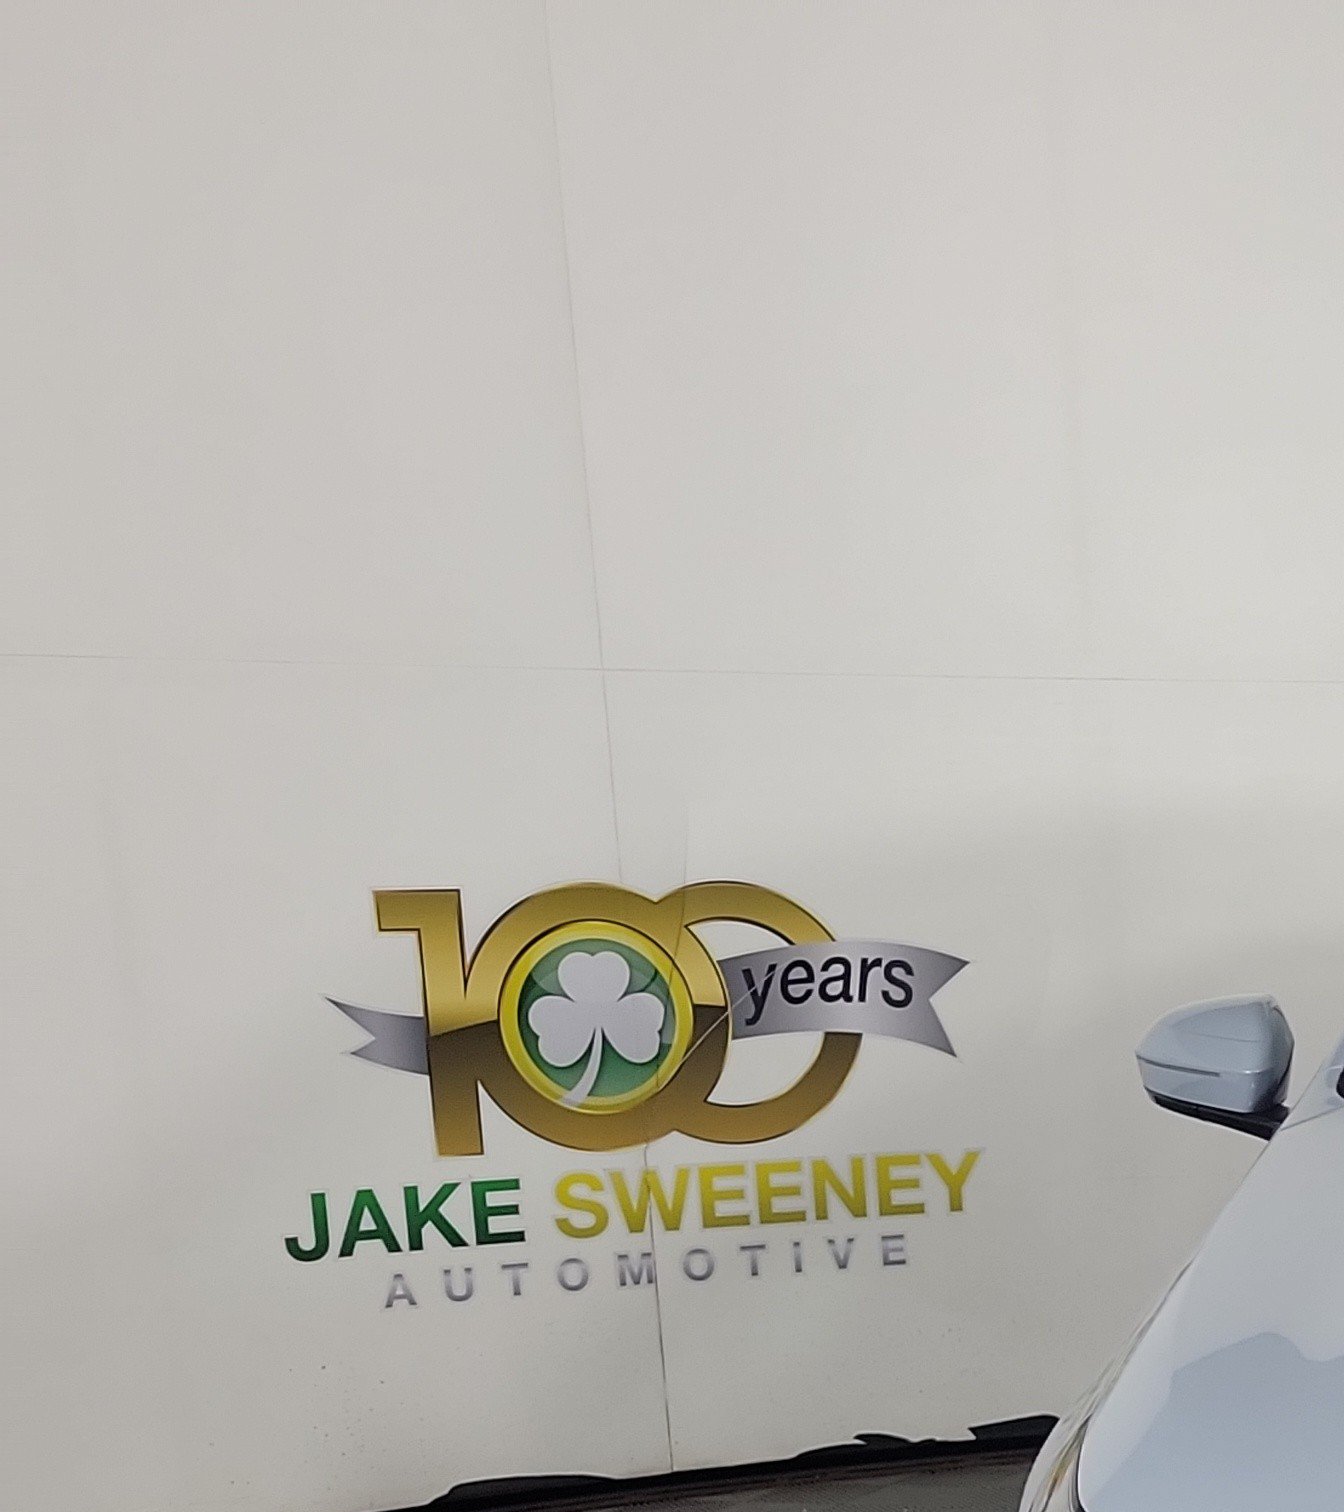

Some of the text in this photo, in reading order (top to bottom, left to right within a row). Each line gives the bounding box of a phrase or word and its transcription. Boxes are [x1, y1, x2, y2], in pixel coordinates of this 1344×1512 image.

[372, 880, 915, 1157] 100 years
[284, 1149, 983, 1262] JAKE SWEENEY
[384, 1234, 909, 1309] AUTOMOTIVE
